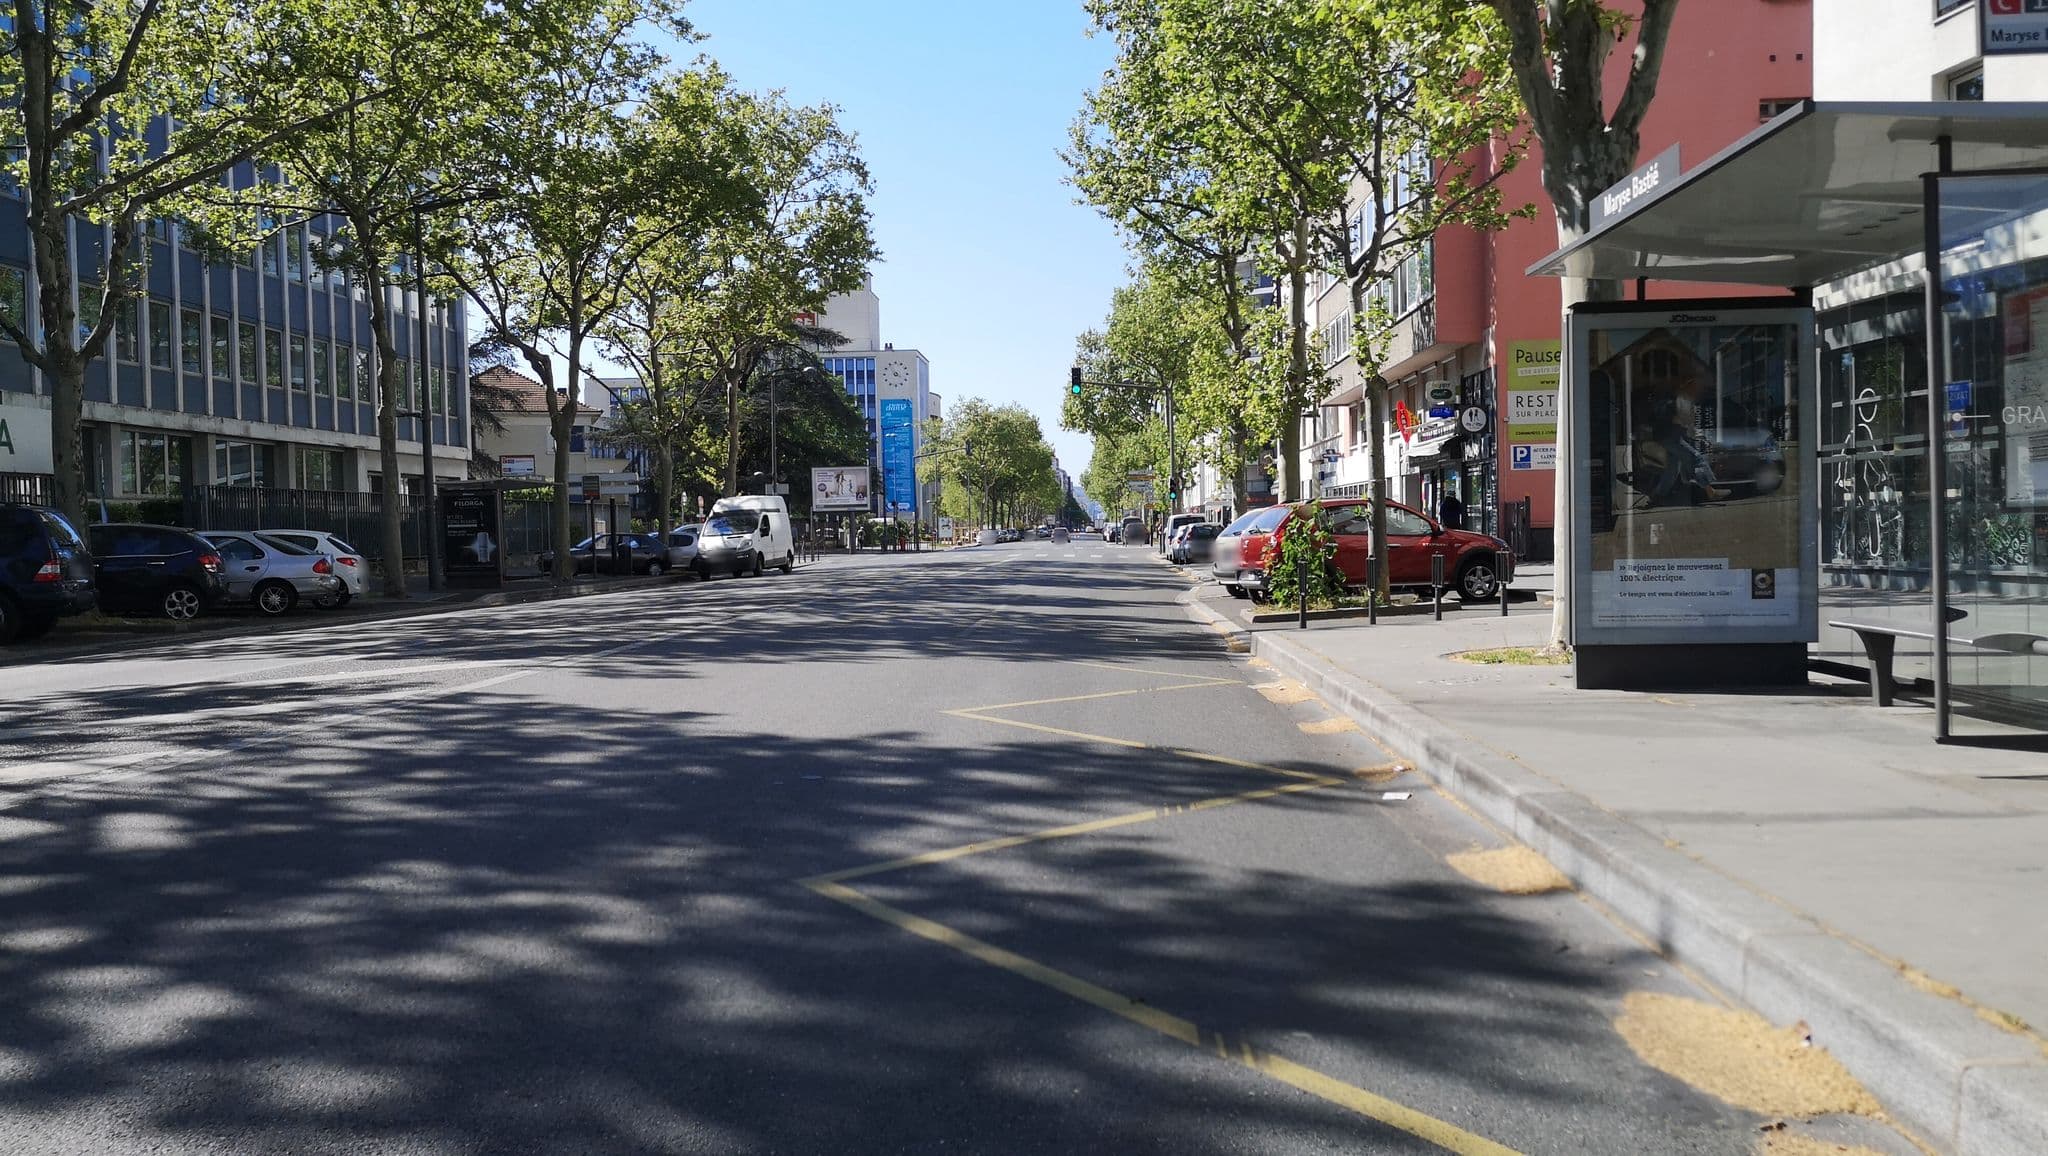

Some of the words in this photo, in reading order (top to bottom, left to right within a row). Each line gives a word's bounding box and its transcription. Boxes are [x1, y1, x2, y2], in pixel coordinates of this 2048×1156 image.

[1991, 29, 2041, 44] Maryse
[1603, 187, 1631, 217] Maryse
[1632, 162, 1659, 199] Bastié
[1669, 313, 1717, 323] JCDecaux
[1515, 349, 1561, 363] Pause
[1516, 394, 1555, 408] REST
[1516, 447, 1528, 462] P
[1667, 563, 1675, 571] le
[1676, 563, 1723, 571] mouvement
[1642, 574, 1686, 583] électrique.
